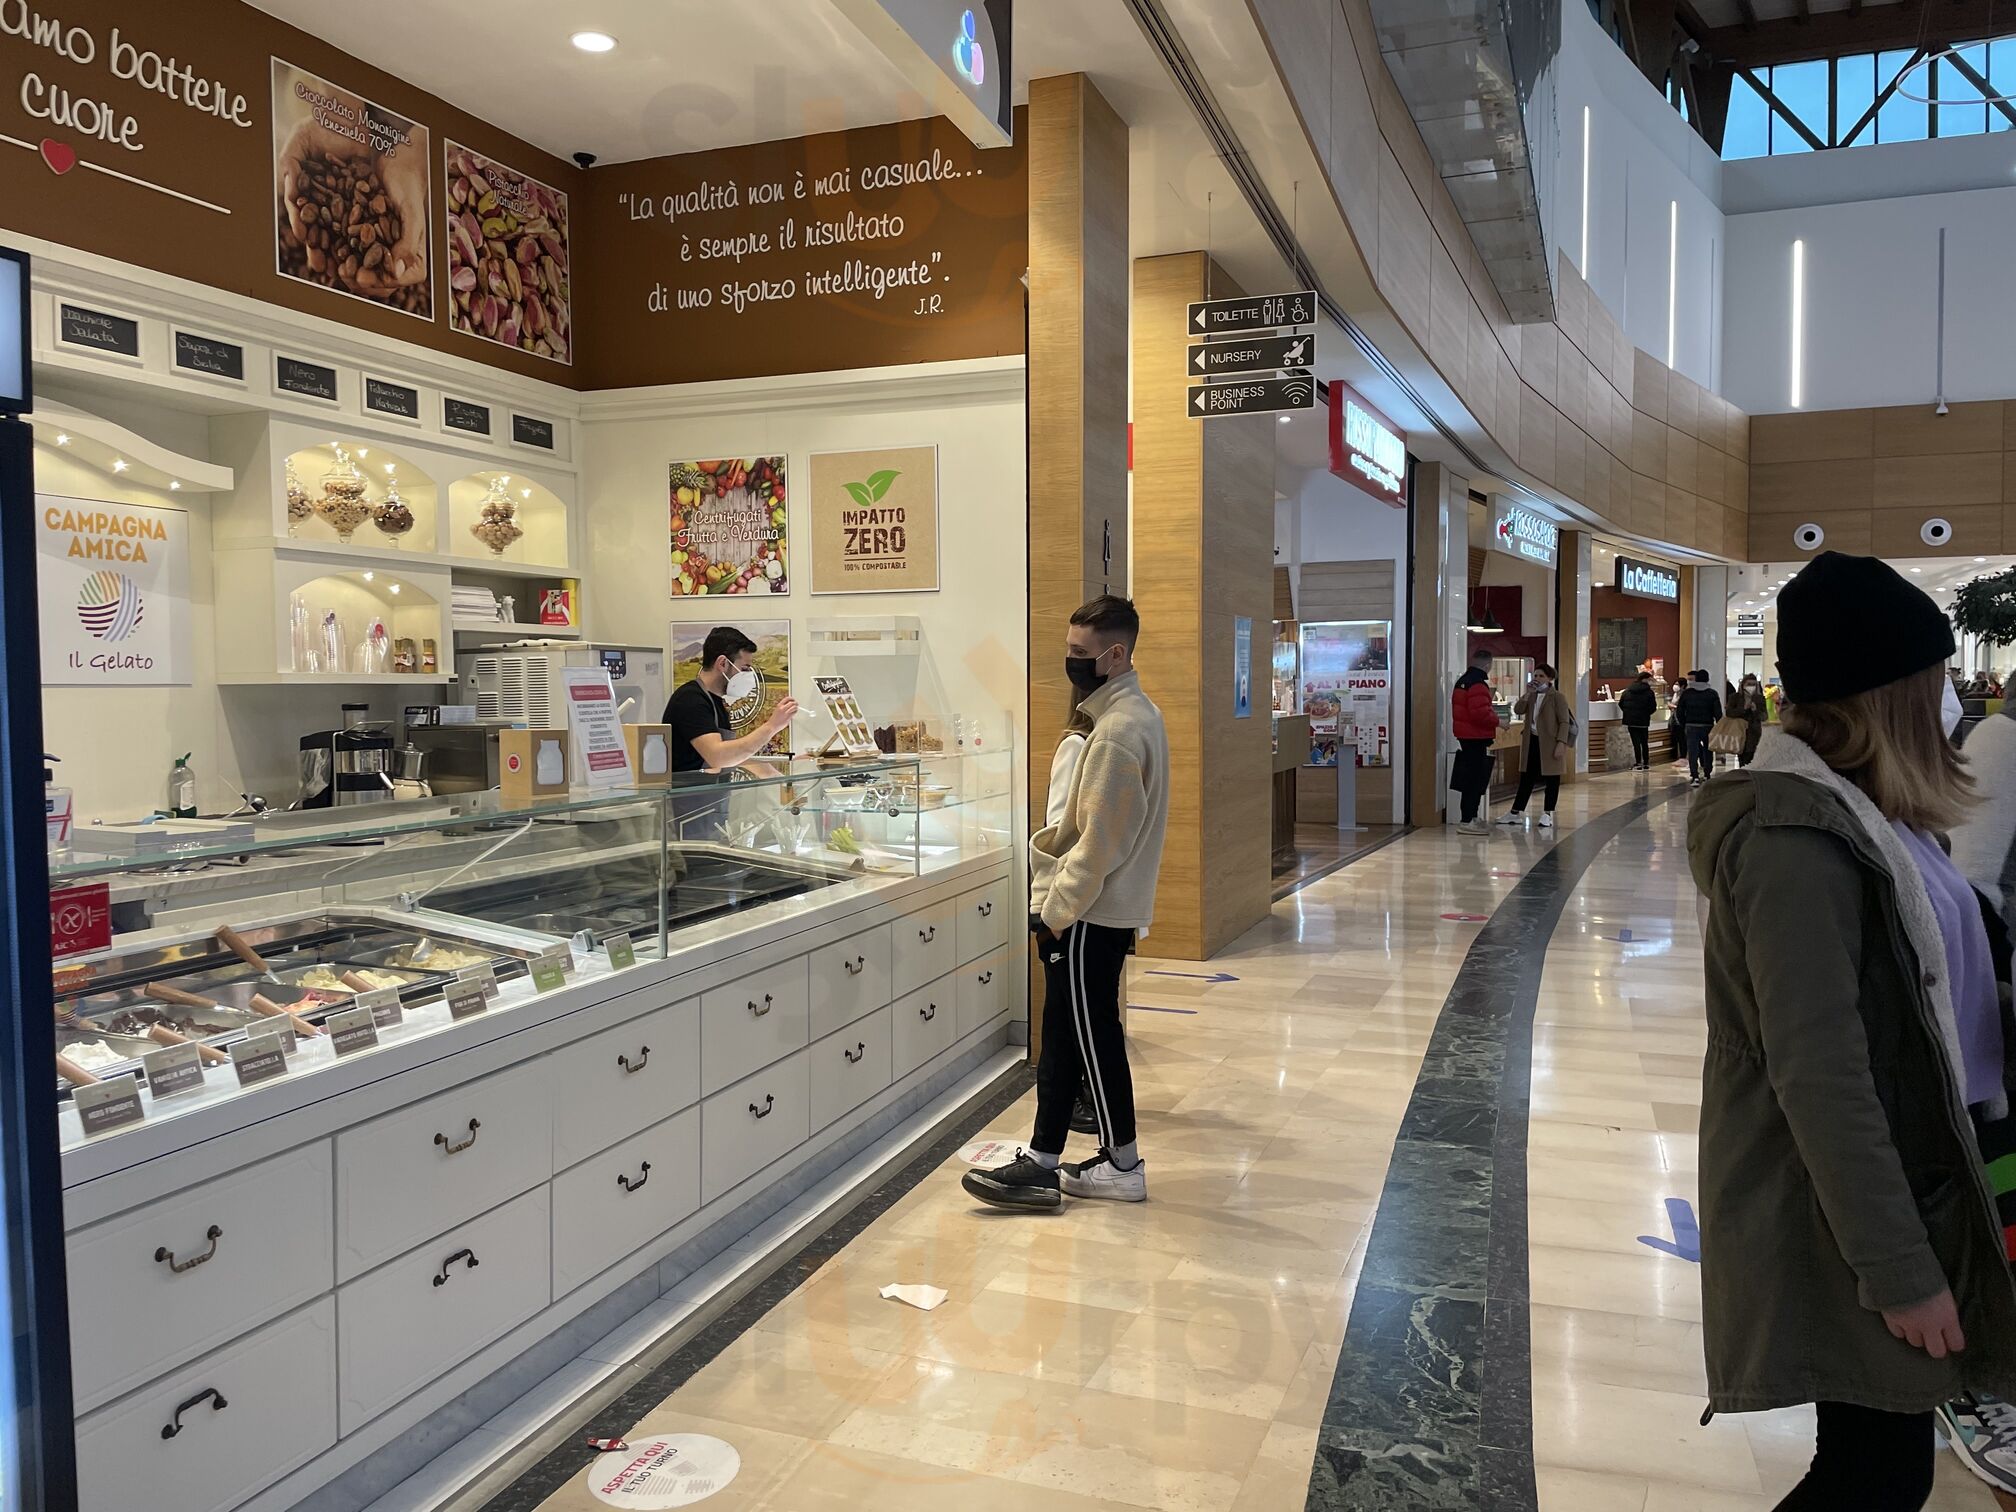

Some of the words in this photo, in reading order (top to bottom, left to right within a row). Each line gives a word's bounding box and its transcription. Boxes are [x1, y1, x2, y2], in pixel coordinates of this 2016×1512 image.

[110, 28, 253, 127] battere
[20, 72, 144, 151] cuore
[295, 82, 355, 120] Cioccolato
[313, 106, 366, 144] Venezuela
[368, 133, 396, 158] 70%
[663, 181, 739, 224] qualità
[748, 182, 784, 206] non
[794, 170, 806, 198] è
[815, 167, 851, 196] mai
[680, 234, 692, 262] è
[699, 231, 771, 264] sempre
[779, 217, 796, 250] il
[805, 212, 904, 248] risultato
[648, 282, 668, 312] di
[678, 285, 712, 310] uno
[721, 276, 795, 314] sforzo
[914, 294, 945, 316] J.R.
[1211, 307, 1259, 323] TOILETTE
[1210, 349, 1262, 364] NURSERY
[1210, 385, 1265, 401] BUSINESS
[1210, 398, 1244, 411] POINT
[44, 507, 168, 541] CAMPAGNA
[694, 508, 762, 529] Centrifugati
[842, 507, 906, 526] IMPATTO
[677, 527, 718, 547] Frutta
[721, 533, 729, 543] e
[730, 523, 779, 543] Verdura
[844, 525, 907, 556] ZERO
[67, 535, 148, 563] AMICA
[844, 563, 861, 572] 100%
[862, 561, 907, 571] COMPOSTABLE
[1623, 563, 1634, 590] La
[68, 650, 83, 669] Il
[90, 651, 154, 673] Gelato
[1348, 679, 1387, 689] PIANO
[602, 1456, 650, 1495] ASPETTA
[648, 1441, 668, 1458] QUI
[621, 1484, 636, 1494] IL
[630, 1471, 652, 1489] TUO
[646, 1448, 678, 1471] TURNO
